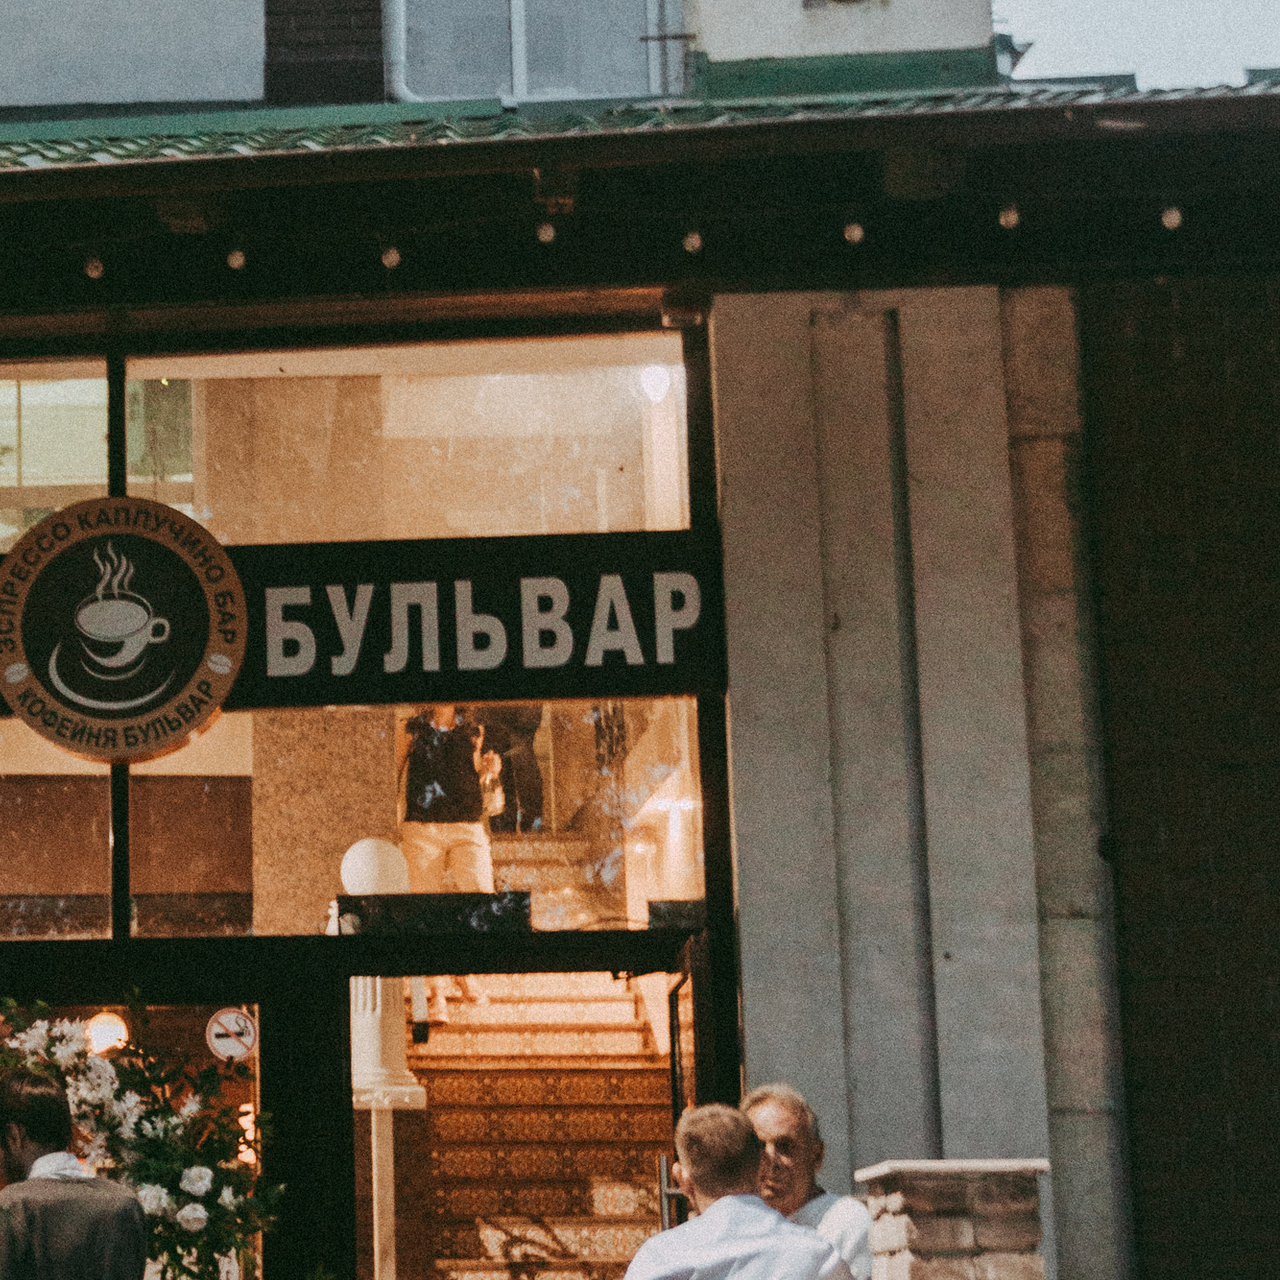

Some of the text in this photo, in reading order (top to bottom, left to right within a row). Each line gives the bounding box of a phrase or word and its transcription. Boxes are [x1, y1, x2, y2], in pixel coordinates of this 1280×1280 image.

[77, 507, 224, 584] КАППУЧИНО
[215, 590, 238, 645] БАР
[264, 571, 702, 677] БУЛЬВАР
[124, 679, 213, 748] БУЛЬВАР
